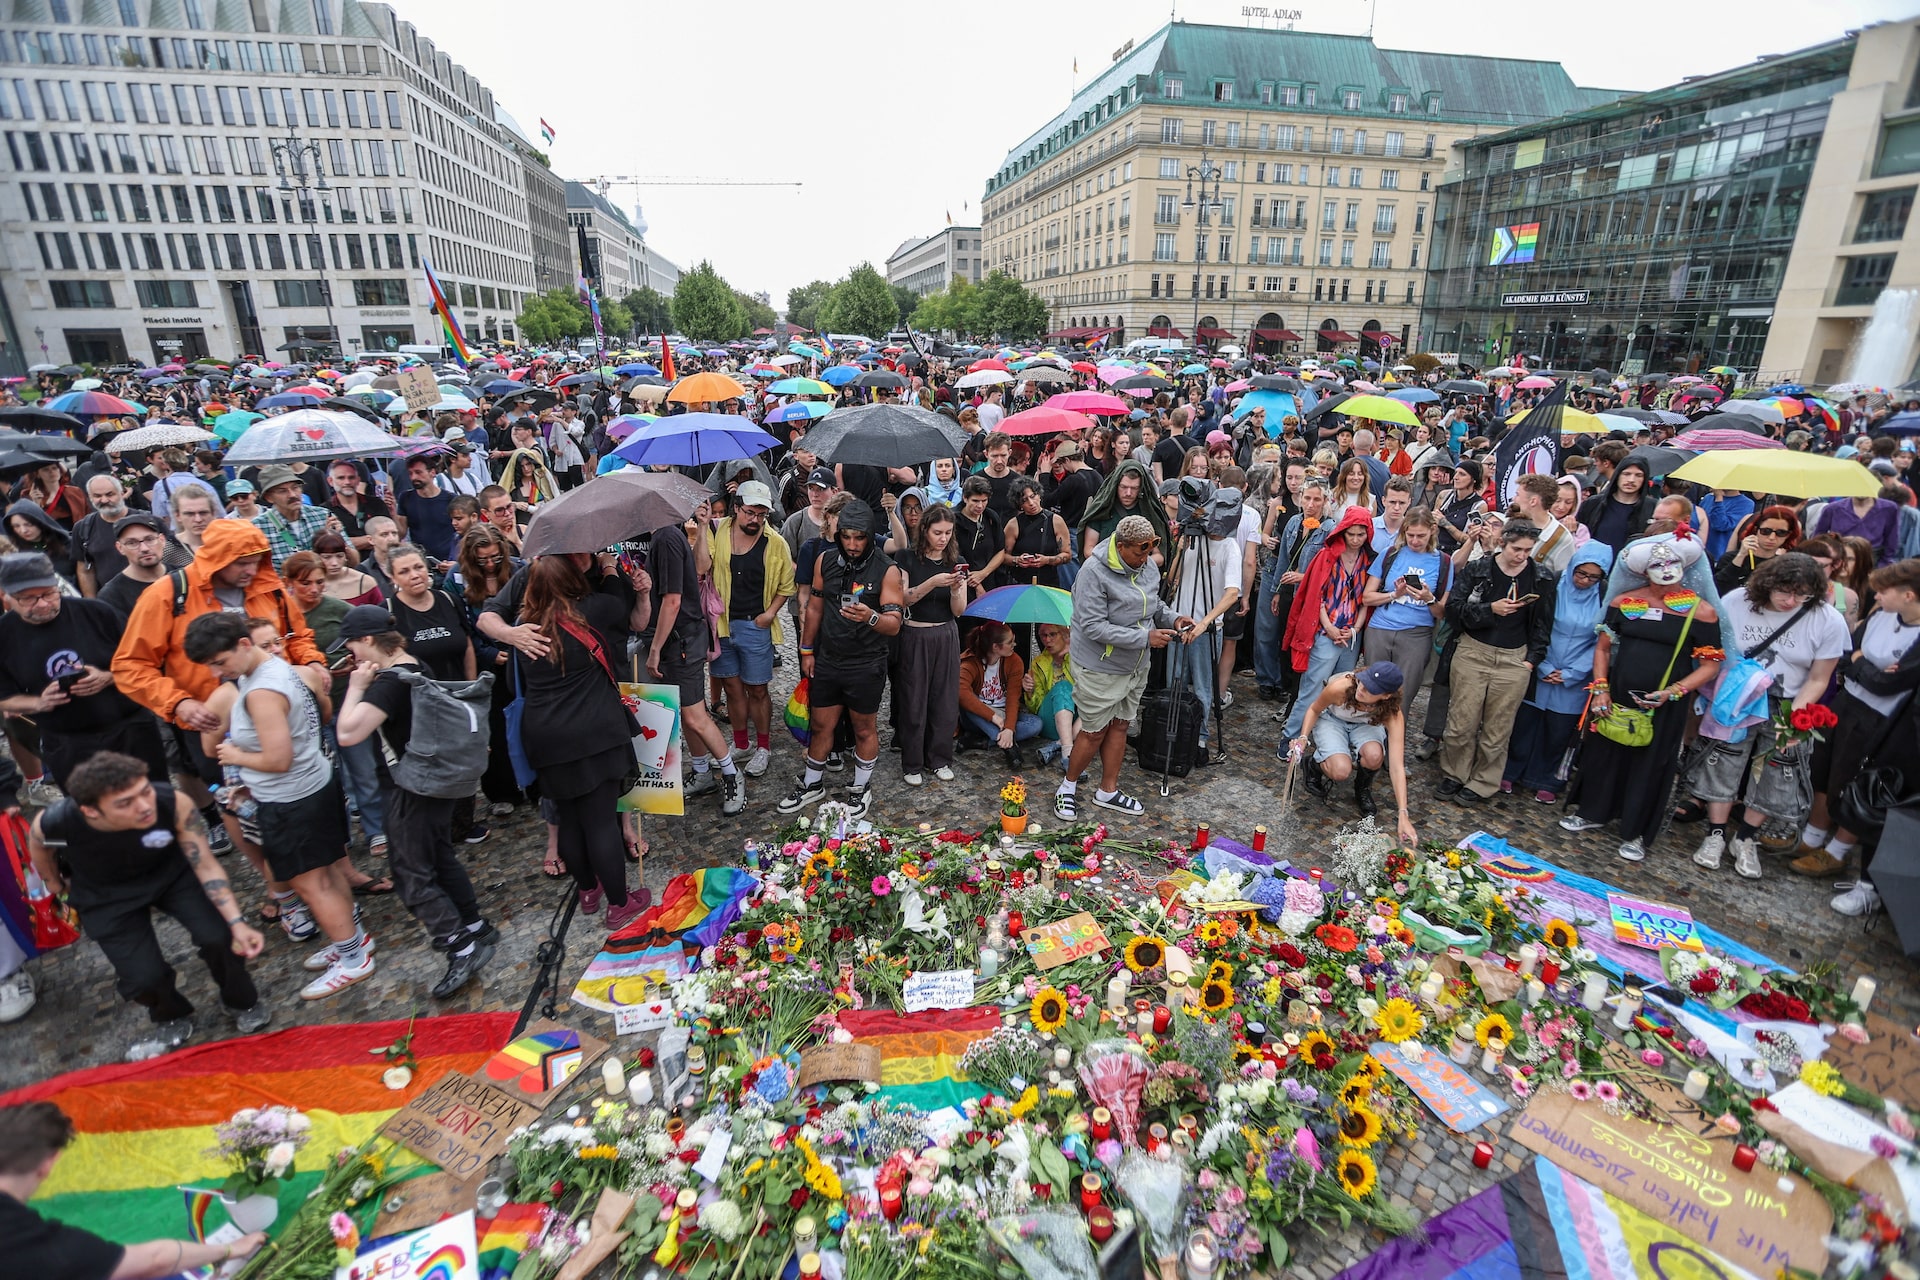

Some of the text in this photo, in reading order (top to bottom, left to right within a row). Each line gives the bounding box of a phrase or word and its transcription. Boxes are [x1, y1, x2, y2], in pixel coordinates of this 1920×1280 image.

[1241, 6, 1302, 20] HOTEL ADLON
[1504, 292, 1586, 304] AKADEMIE DER KÜNSTE
[290, 441, 334, 451] BERLIN
[1407, 566, 1425, 576] NO
[644, 771, 663, 780] ASS:
[651, 780, 674, 789] HASS
[1040, 919, 1071, 936] ALL
[1620, 906, 1693, 933] LOVE
[1630, 920, 1689, 942] ARE
[1026, 922, 1099, 955] CONQUERS
[1061, 935, 1109, 961] LOVE
[932, 996, 966, 1006] DANCE
[1421, 1050, 1479, 1096] HASS
[438, 1072, 524, 1129] WEAPON!
[1376, 1049, 1465, 1128] TRAUER
[410, 1087, 498, 1148] IS NOT YOUR
[1668, 1099, 1717, 1135] We
[389, 1117, 481, 1174] OUR GRIEF
[1591, 1126, 1732, 1207] Queerness
[1646, 1133, 1788, 1219] will always
[1642, 1179, 1720, 1242] halten
